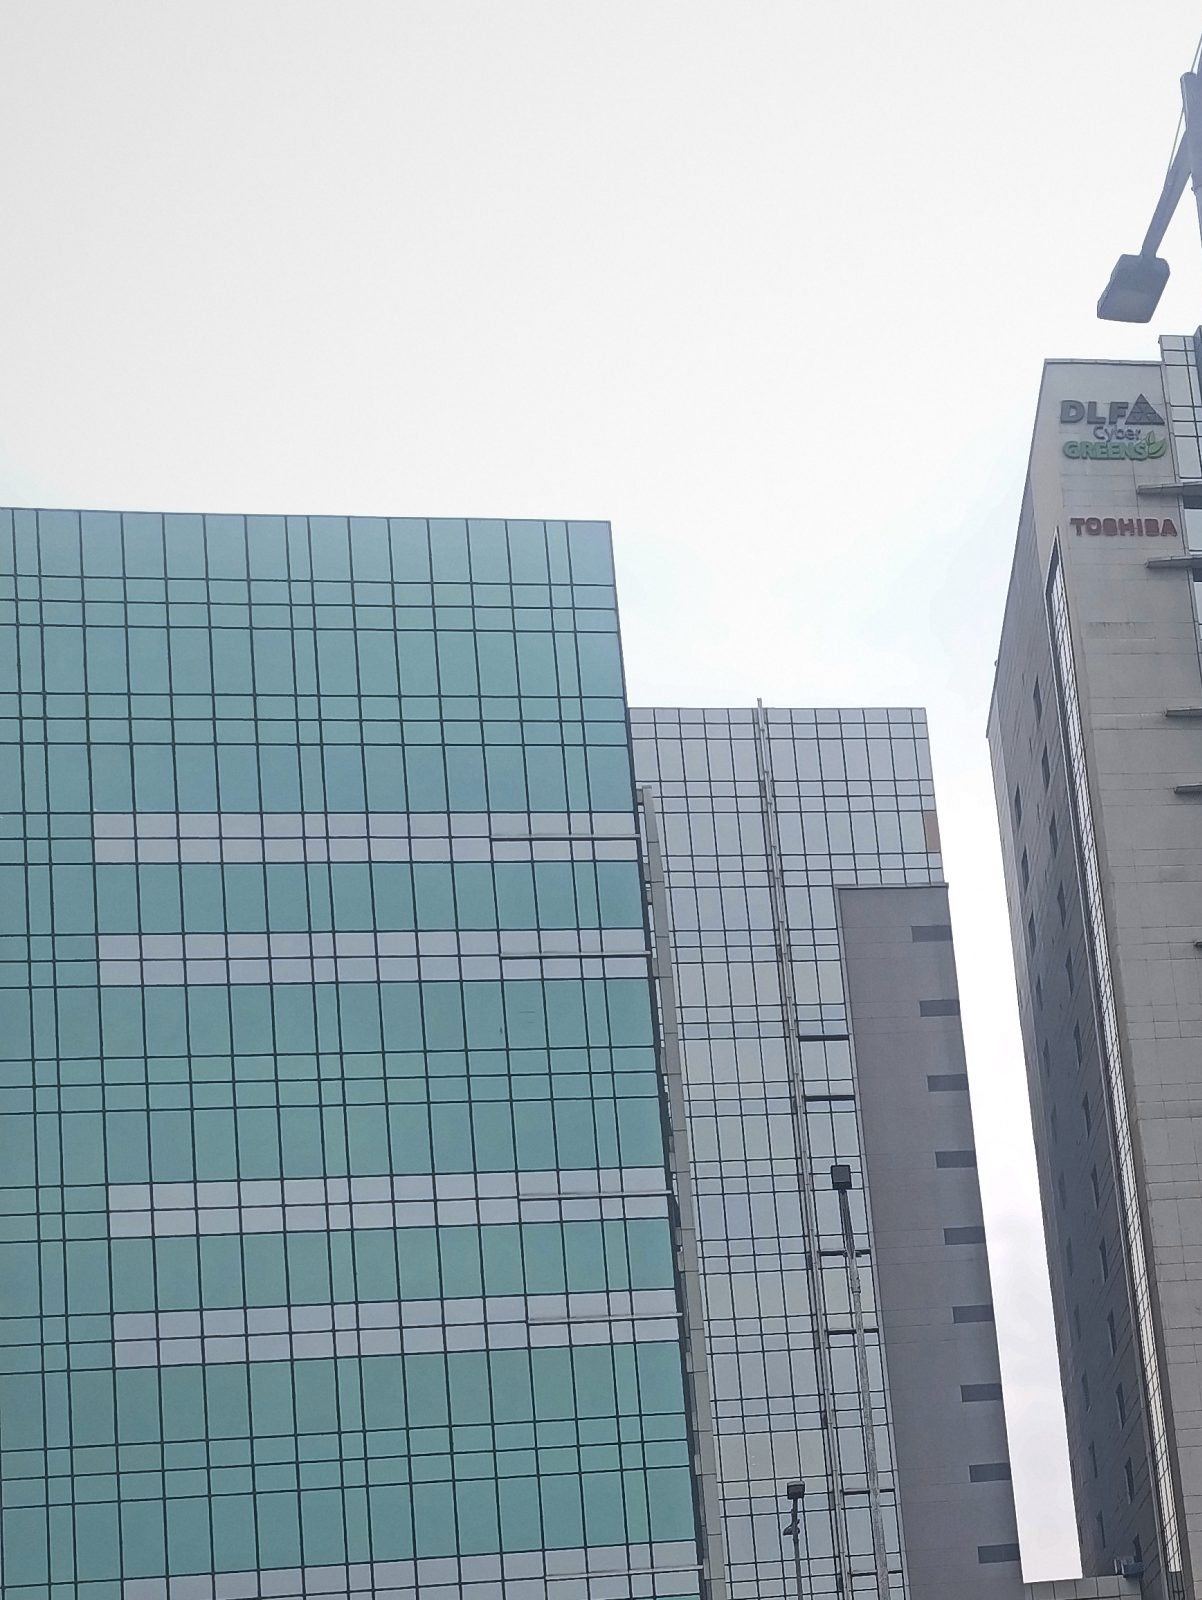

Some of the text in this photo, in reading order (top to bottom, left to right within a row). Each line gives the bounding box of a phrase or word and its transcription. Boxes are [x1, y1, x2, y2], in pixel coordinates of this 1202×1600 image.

[1060, 400, 1129, 425] DLF
[1093, 426, 1141, 442] Cyber
[1063, 441, 1149, 461] GREENS
[1070, 517, 1178, 537] TOSHIBA
